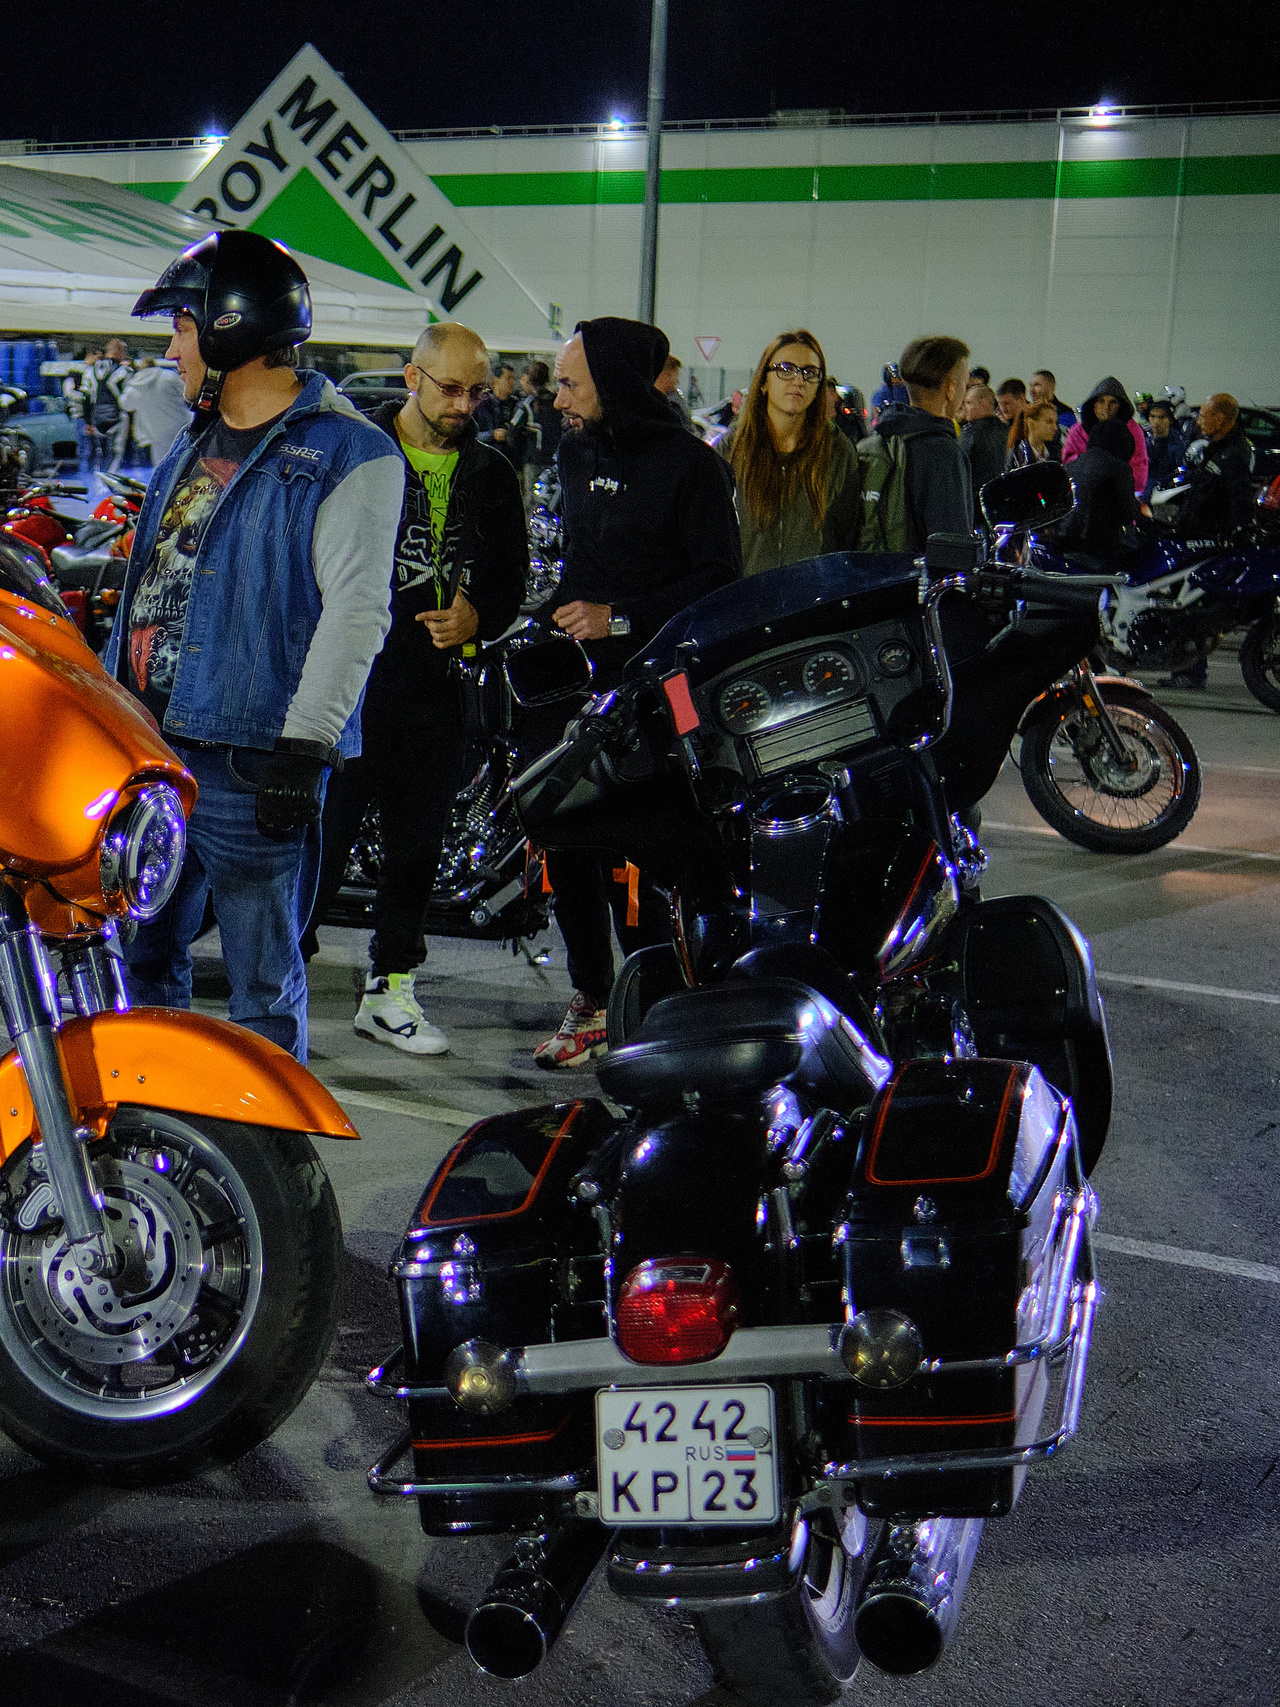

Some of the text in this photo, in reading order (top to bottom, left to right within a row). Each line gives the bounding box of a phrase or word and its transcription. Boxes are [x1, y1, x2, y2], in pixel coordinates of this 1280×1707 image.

[277, 75, 483, 313] MERLIN
[686, 1446, 724, 1461] RUS
[703, 1469, 758, 1512] 23
